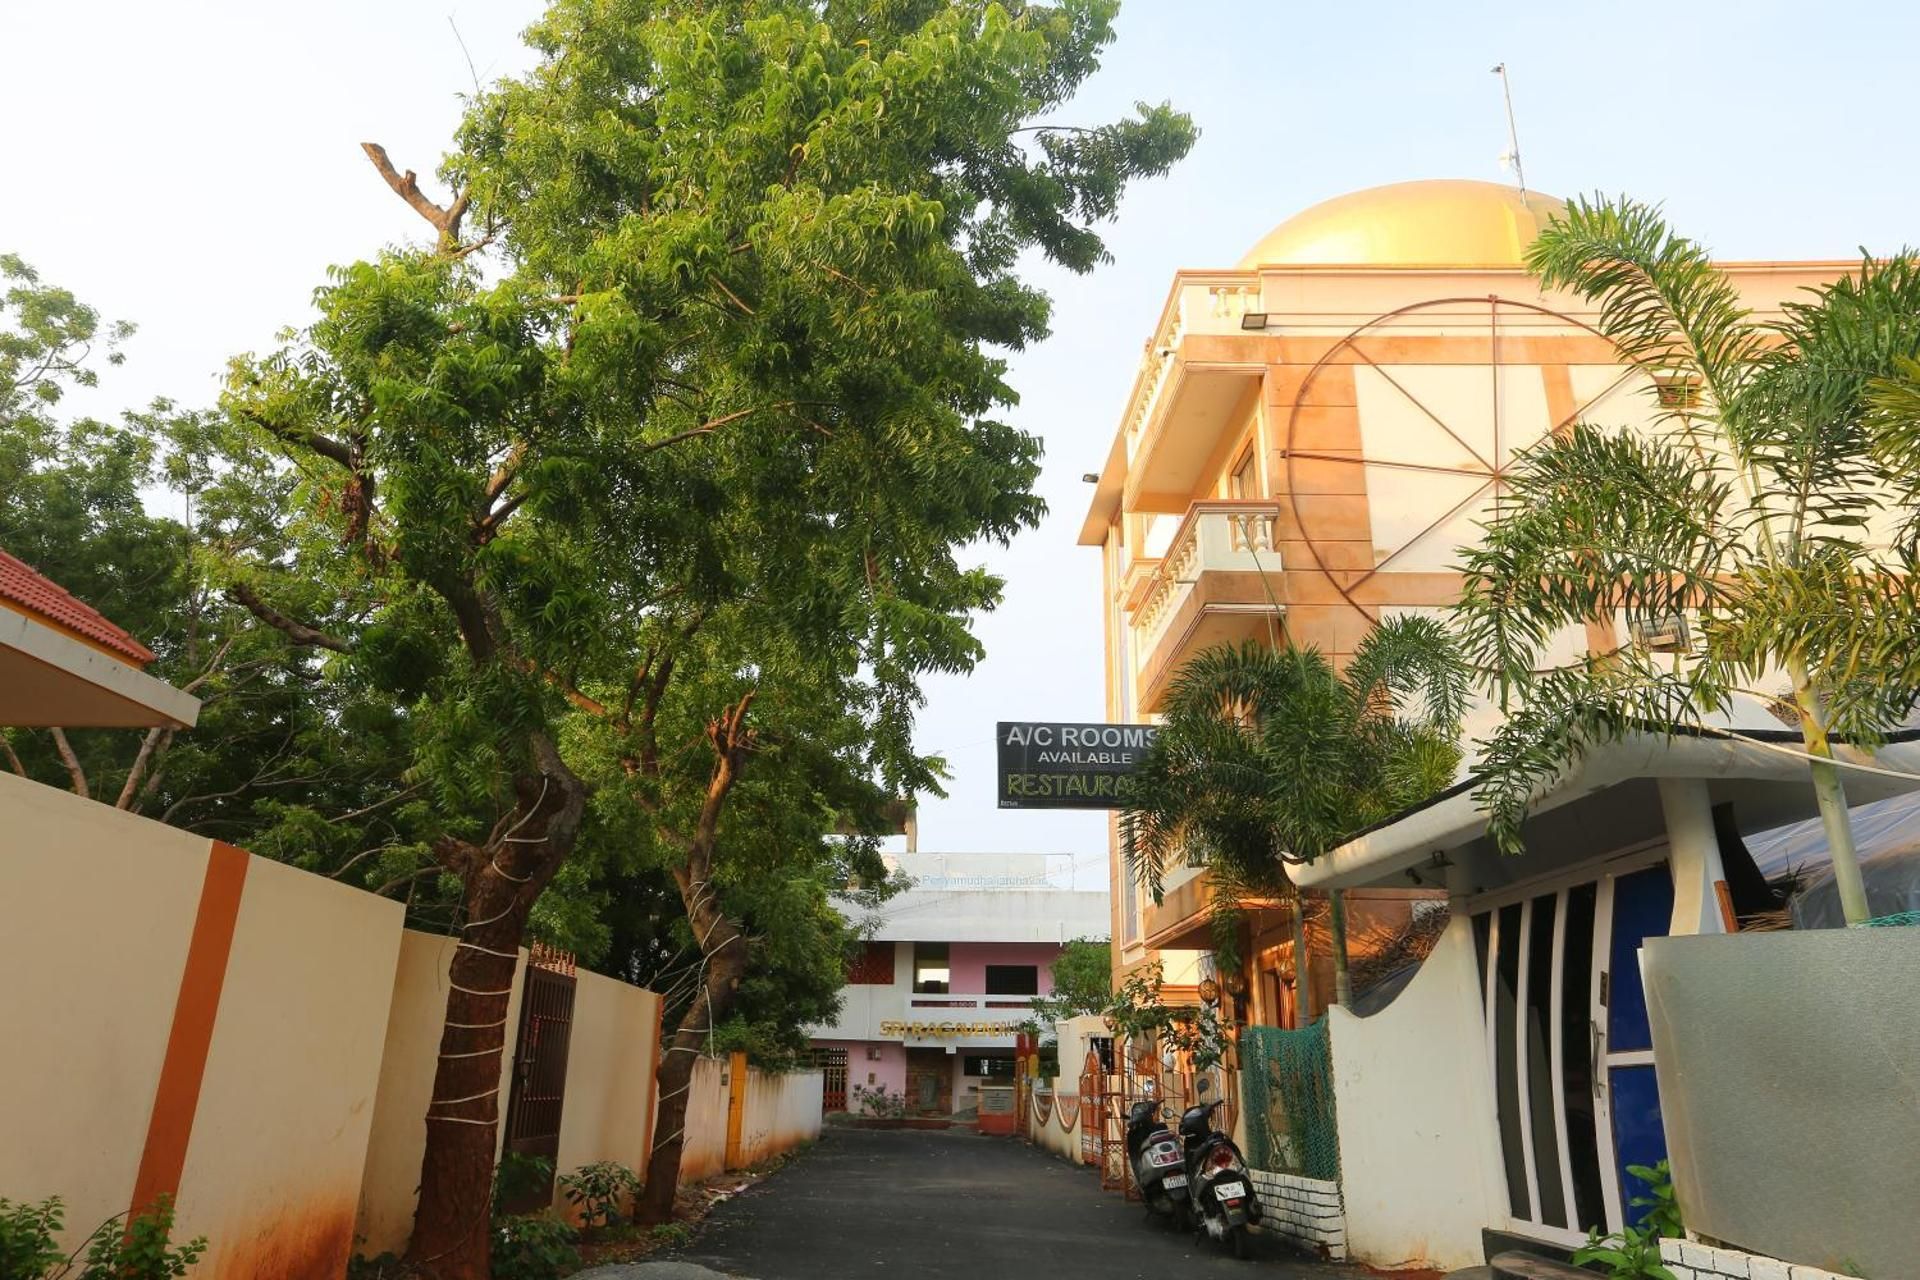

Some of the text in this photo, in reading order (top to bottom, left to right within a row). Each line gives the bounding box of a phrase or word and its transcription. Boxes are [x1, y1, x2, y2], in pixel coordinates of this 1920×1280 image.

[1006, 726, 1157, 748] A/C ROOMS
[1038, 751, 1132, 764] AVAILABLE
[1007, 773, 1137, 797] RESTAURA
